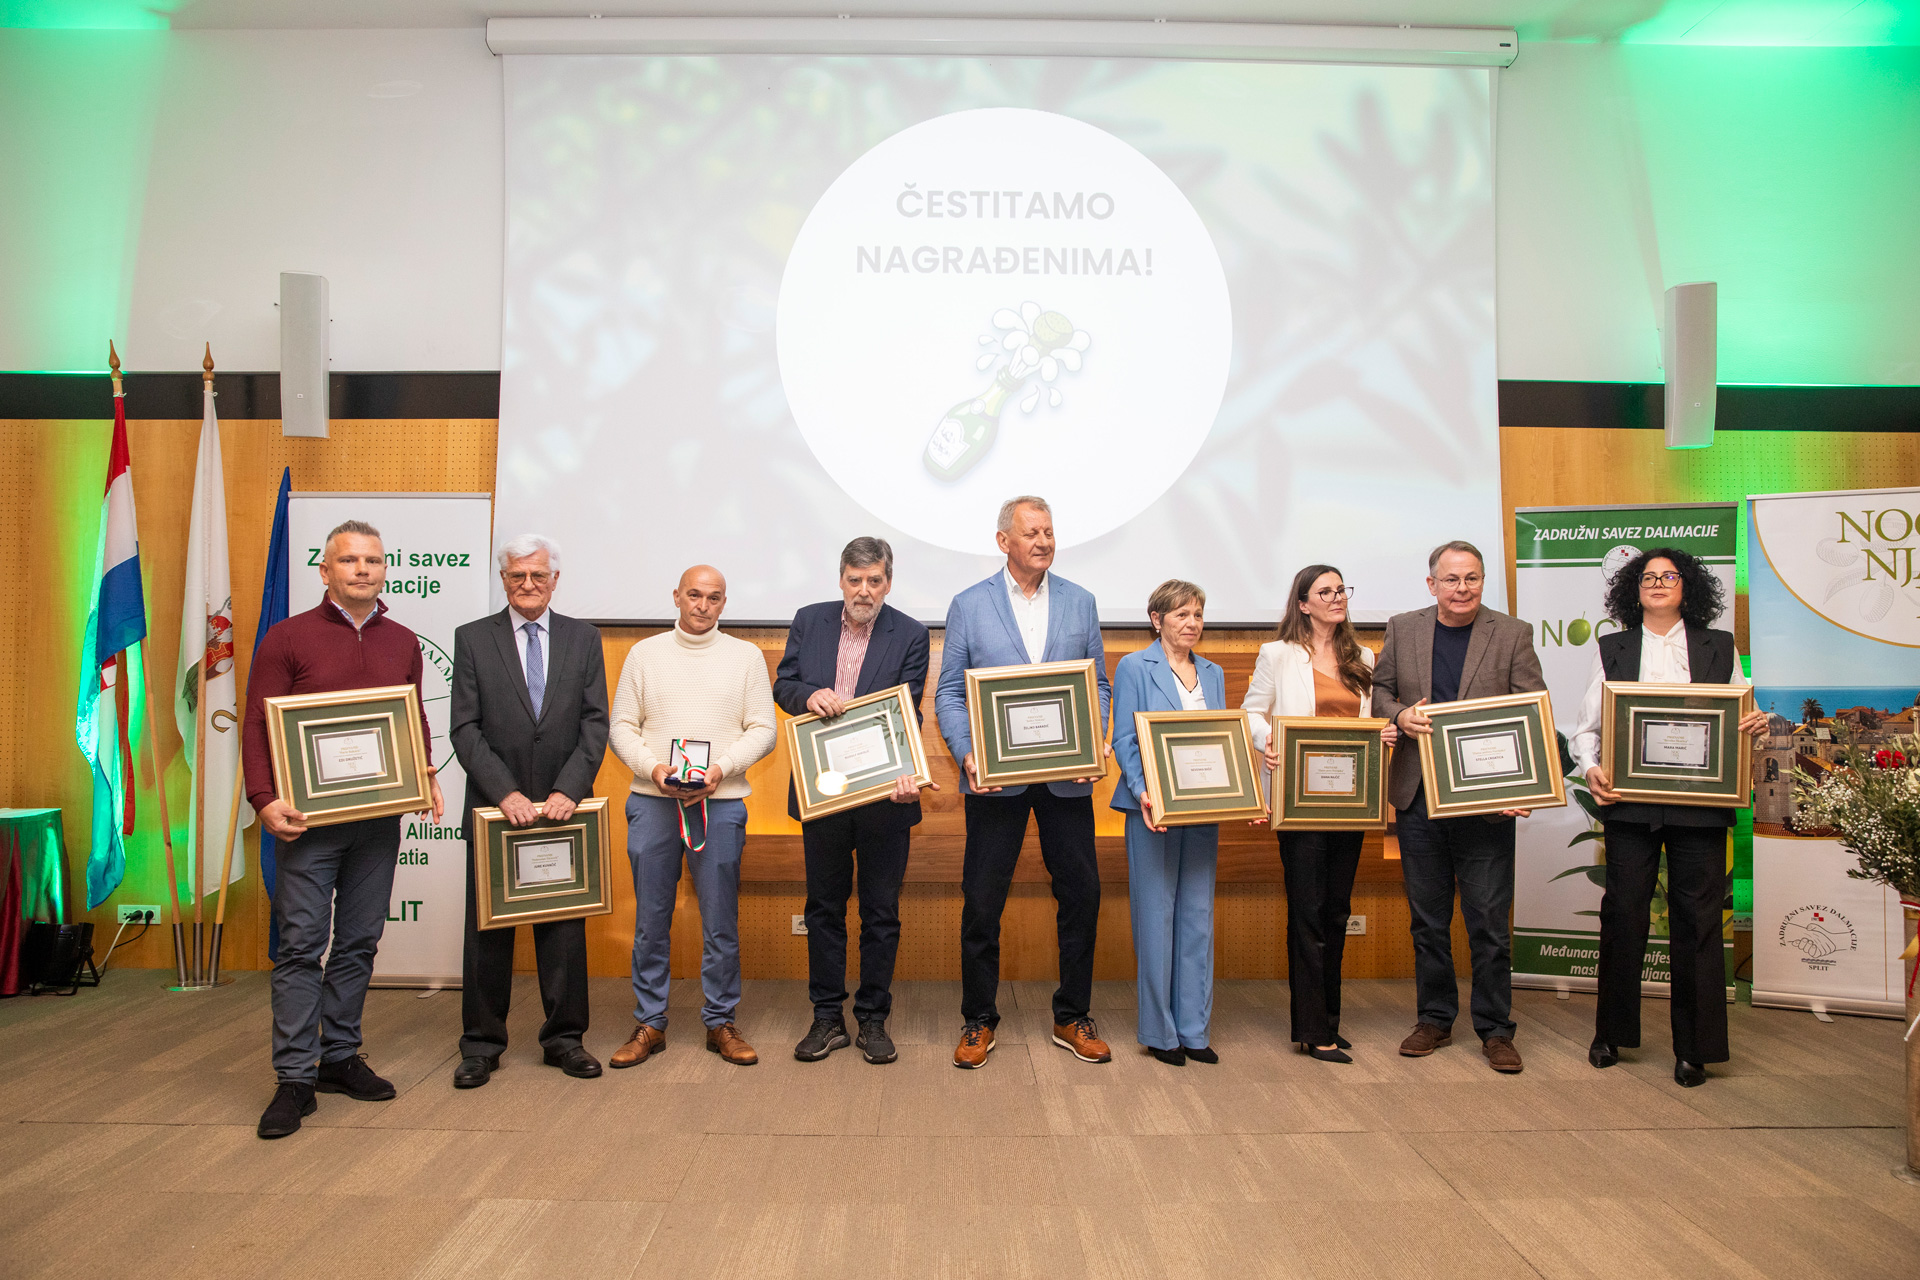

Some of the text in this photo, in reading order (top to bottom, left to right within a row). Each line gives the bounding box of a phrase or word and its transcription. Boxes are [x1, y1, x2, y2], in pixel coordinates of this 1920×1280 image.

[896, 183, 1115, 220] ČESTITAMO
[856, 245, 1153, 276] NAGRAĐENIMA!
[1533, 525, 1719, 540] ZADRUŽNI SAVEZ DALMACIJE
[1835, 508, 1920, 543] NO
[409, 553, 470, 567] savez
[386, 901, 423, 921] LIT
[1799, 904, 1828, 912] SAVEZ
[1829, 908, 1857, 951] DALMACIJE
[1540, 944, 1600, 959] Međunaro
